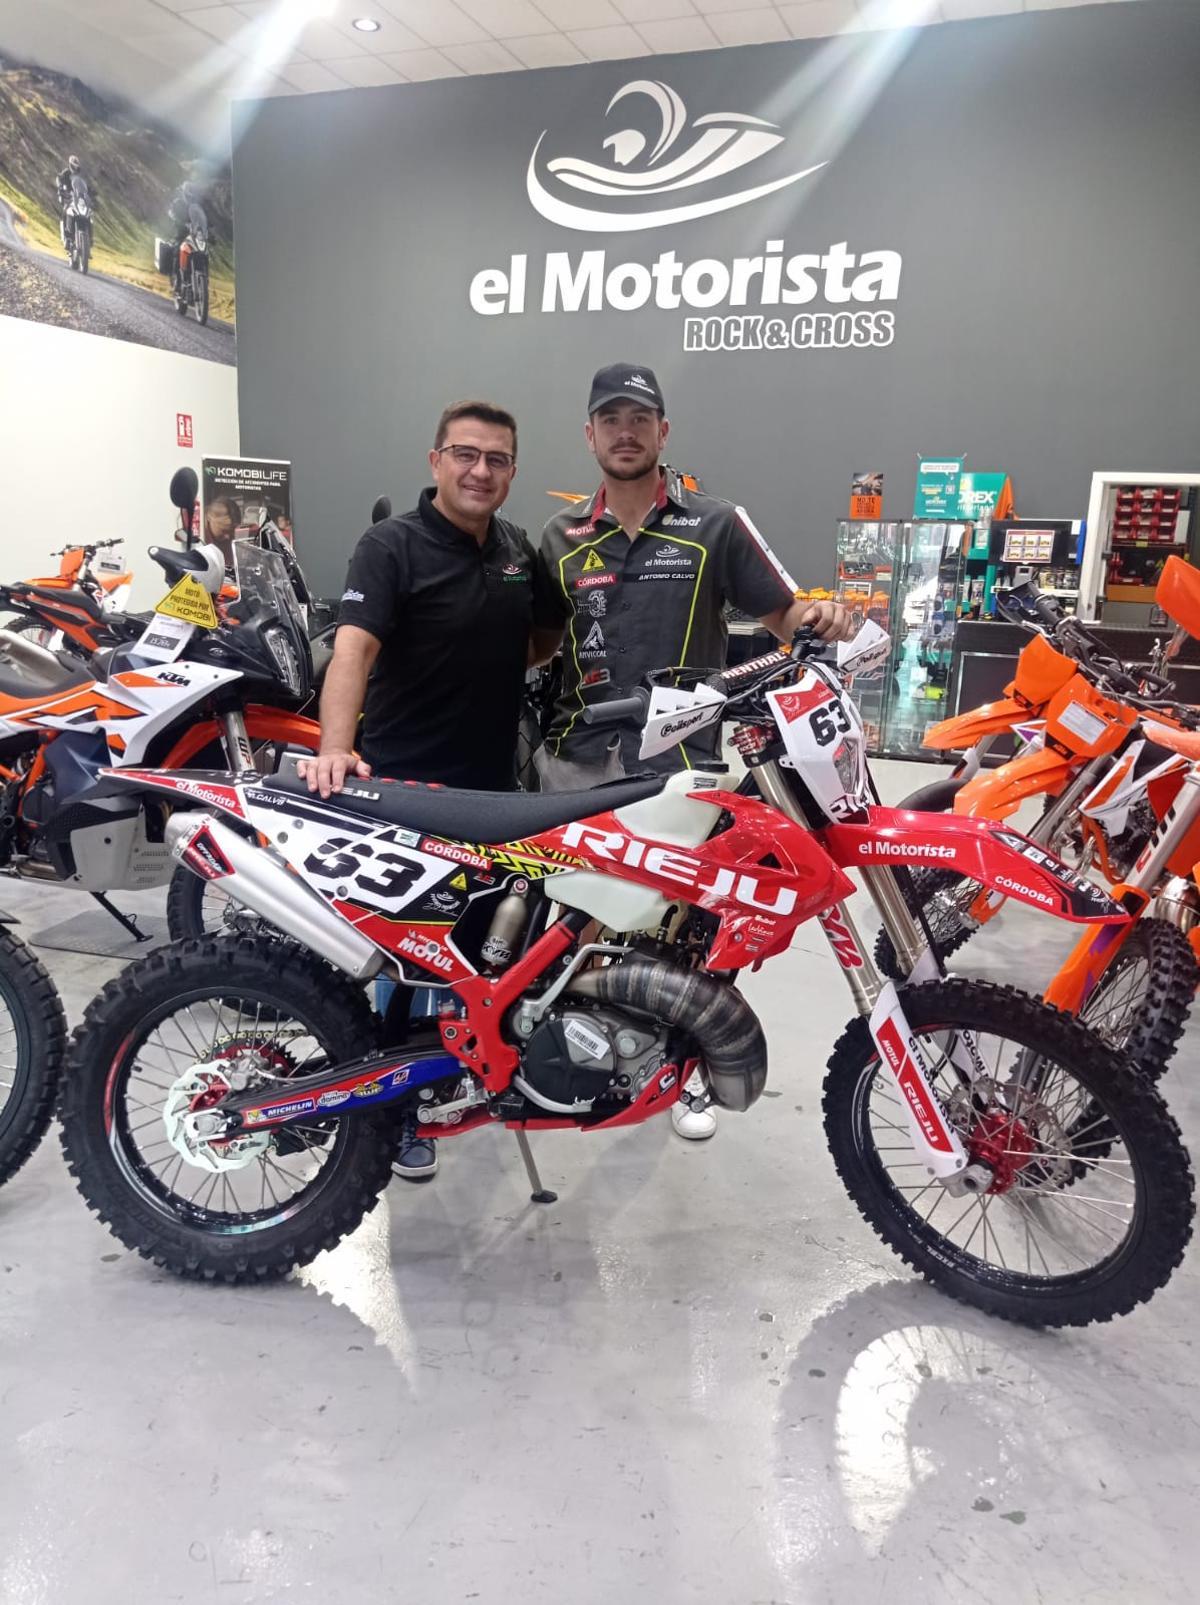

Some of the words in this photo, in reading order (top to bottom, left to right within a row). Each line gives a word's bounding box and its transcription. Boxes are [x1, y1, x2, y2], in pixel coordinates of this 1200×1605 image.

[469, 254, 527, 315] el
[541, 240, 902, 313] Motorista
[217, 467, 287, 481] KOMOBILIFE
[577, 577, 614, 588] CÓRDOBA
[176, 607, 211, 621] KOMOBI
[158, 671, 191, 687] KTM
[720, 652, 787, 679] RENTHAL
[809, 699, 851, 747] 63
[187, 783, 235, 808] Motorista
[424, 840, 488, 869] CÓRDOBA
[859, 841, 873, 854] el
[875, 841, 957, 858] Motorista
[562, 822, 798, 916] RIEJU
[994, 875, 1054, 906] CÓRDOBA
[397, 937, 453, 972] MOTUL
[881, 1039, 900, 1067] MOTUL
[267, 1100, 313, 1117] MICHELIN
[903, 1081, 939, 1143] RIEJU
